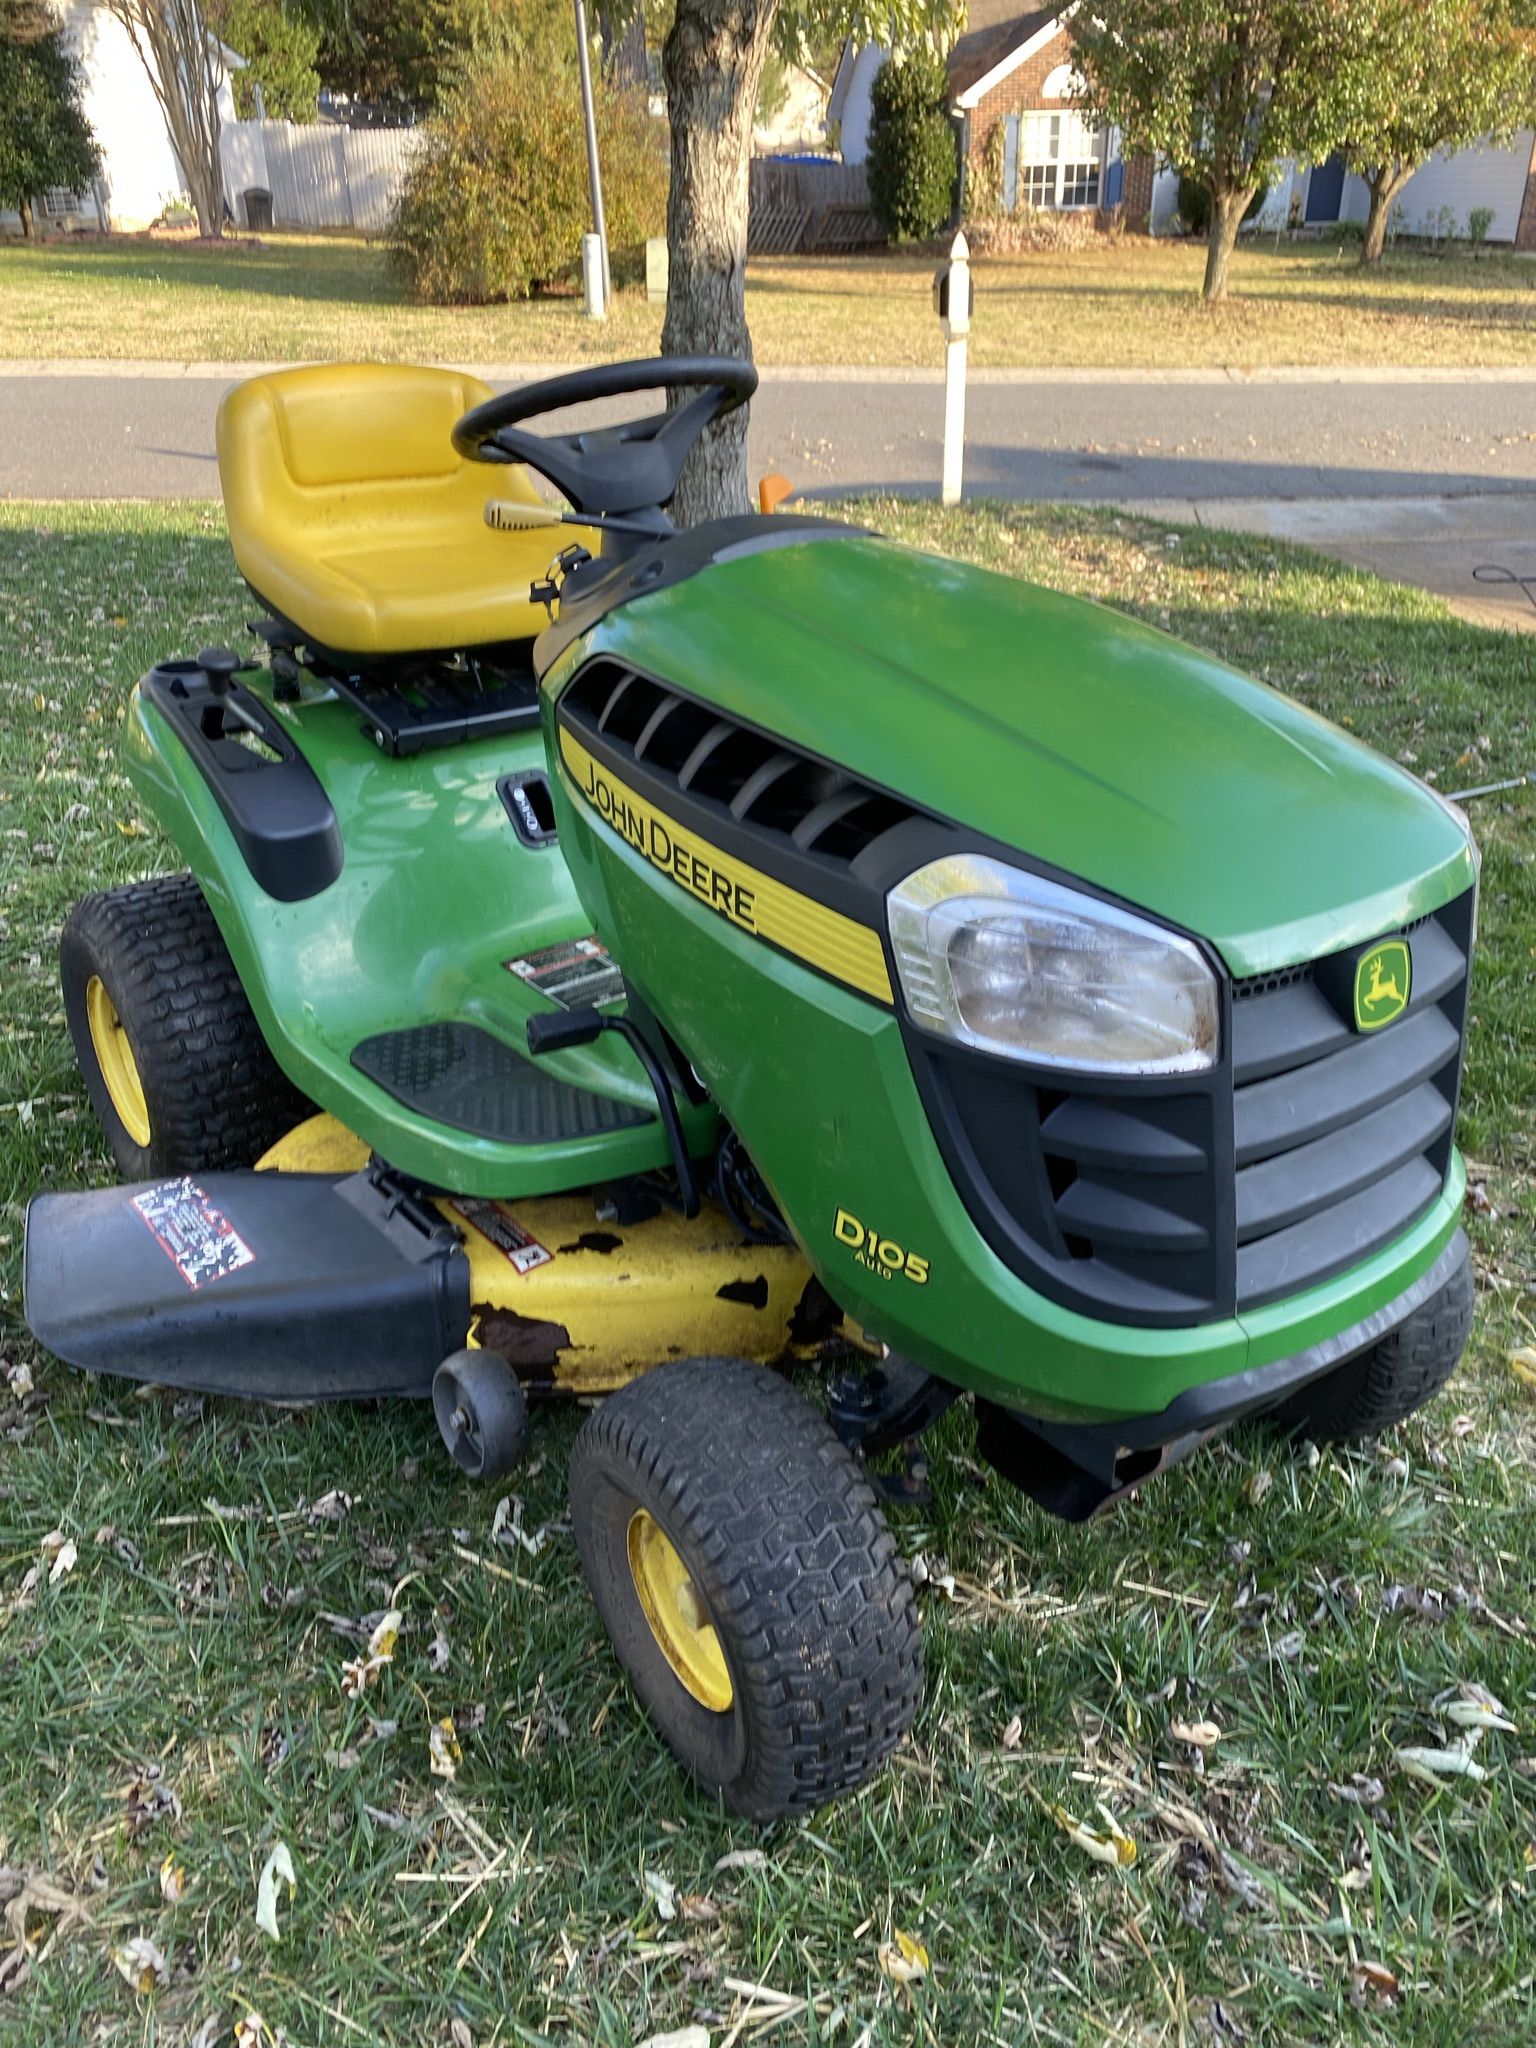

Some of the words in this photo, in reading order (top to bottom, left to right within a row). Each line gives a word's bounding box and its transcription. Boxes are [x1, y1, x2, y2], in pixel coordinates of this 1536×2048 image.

[584, 761, 645, 849] JOHN
[650, 818, 756, 926] DEERE
[834, 1207, 929, 1284] D105
